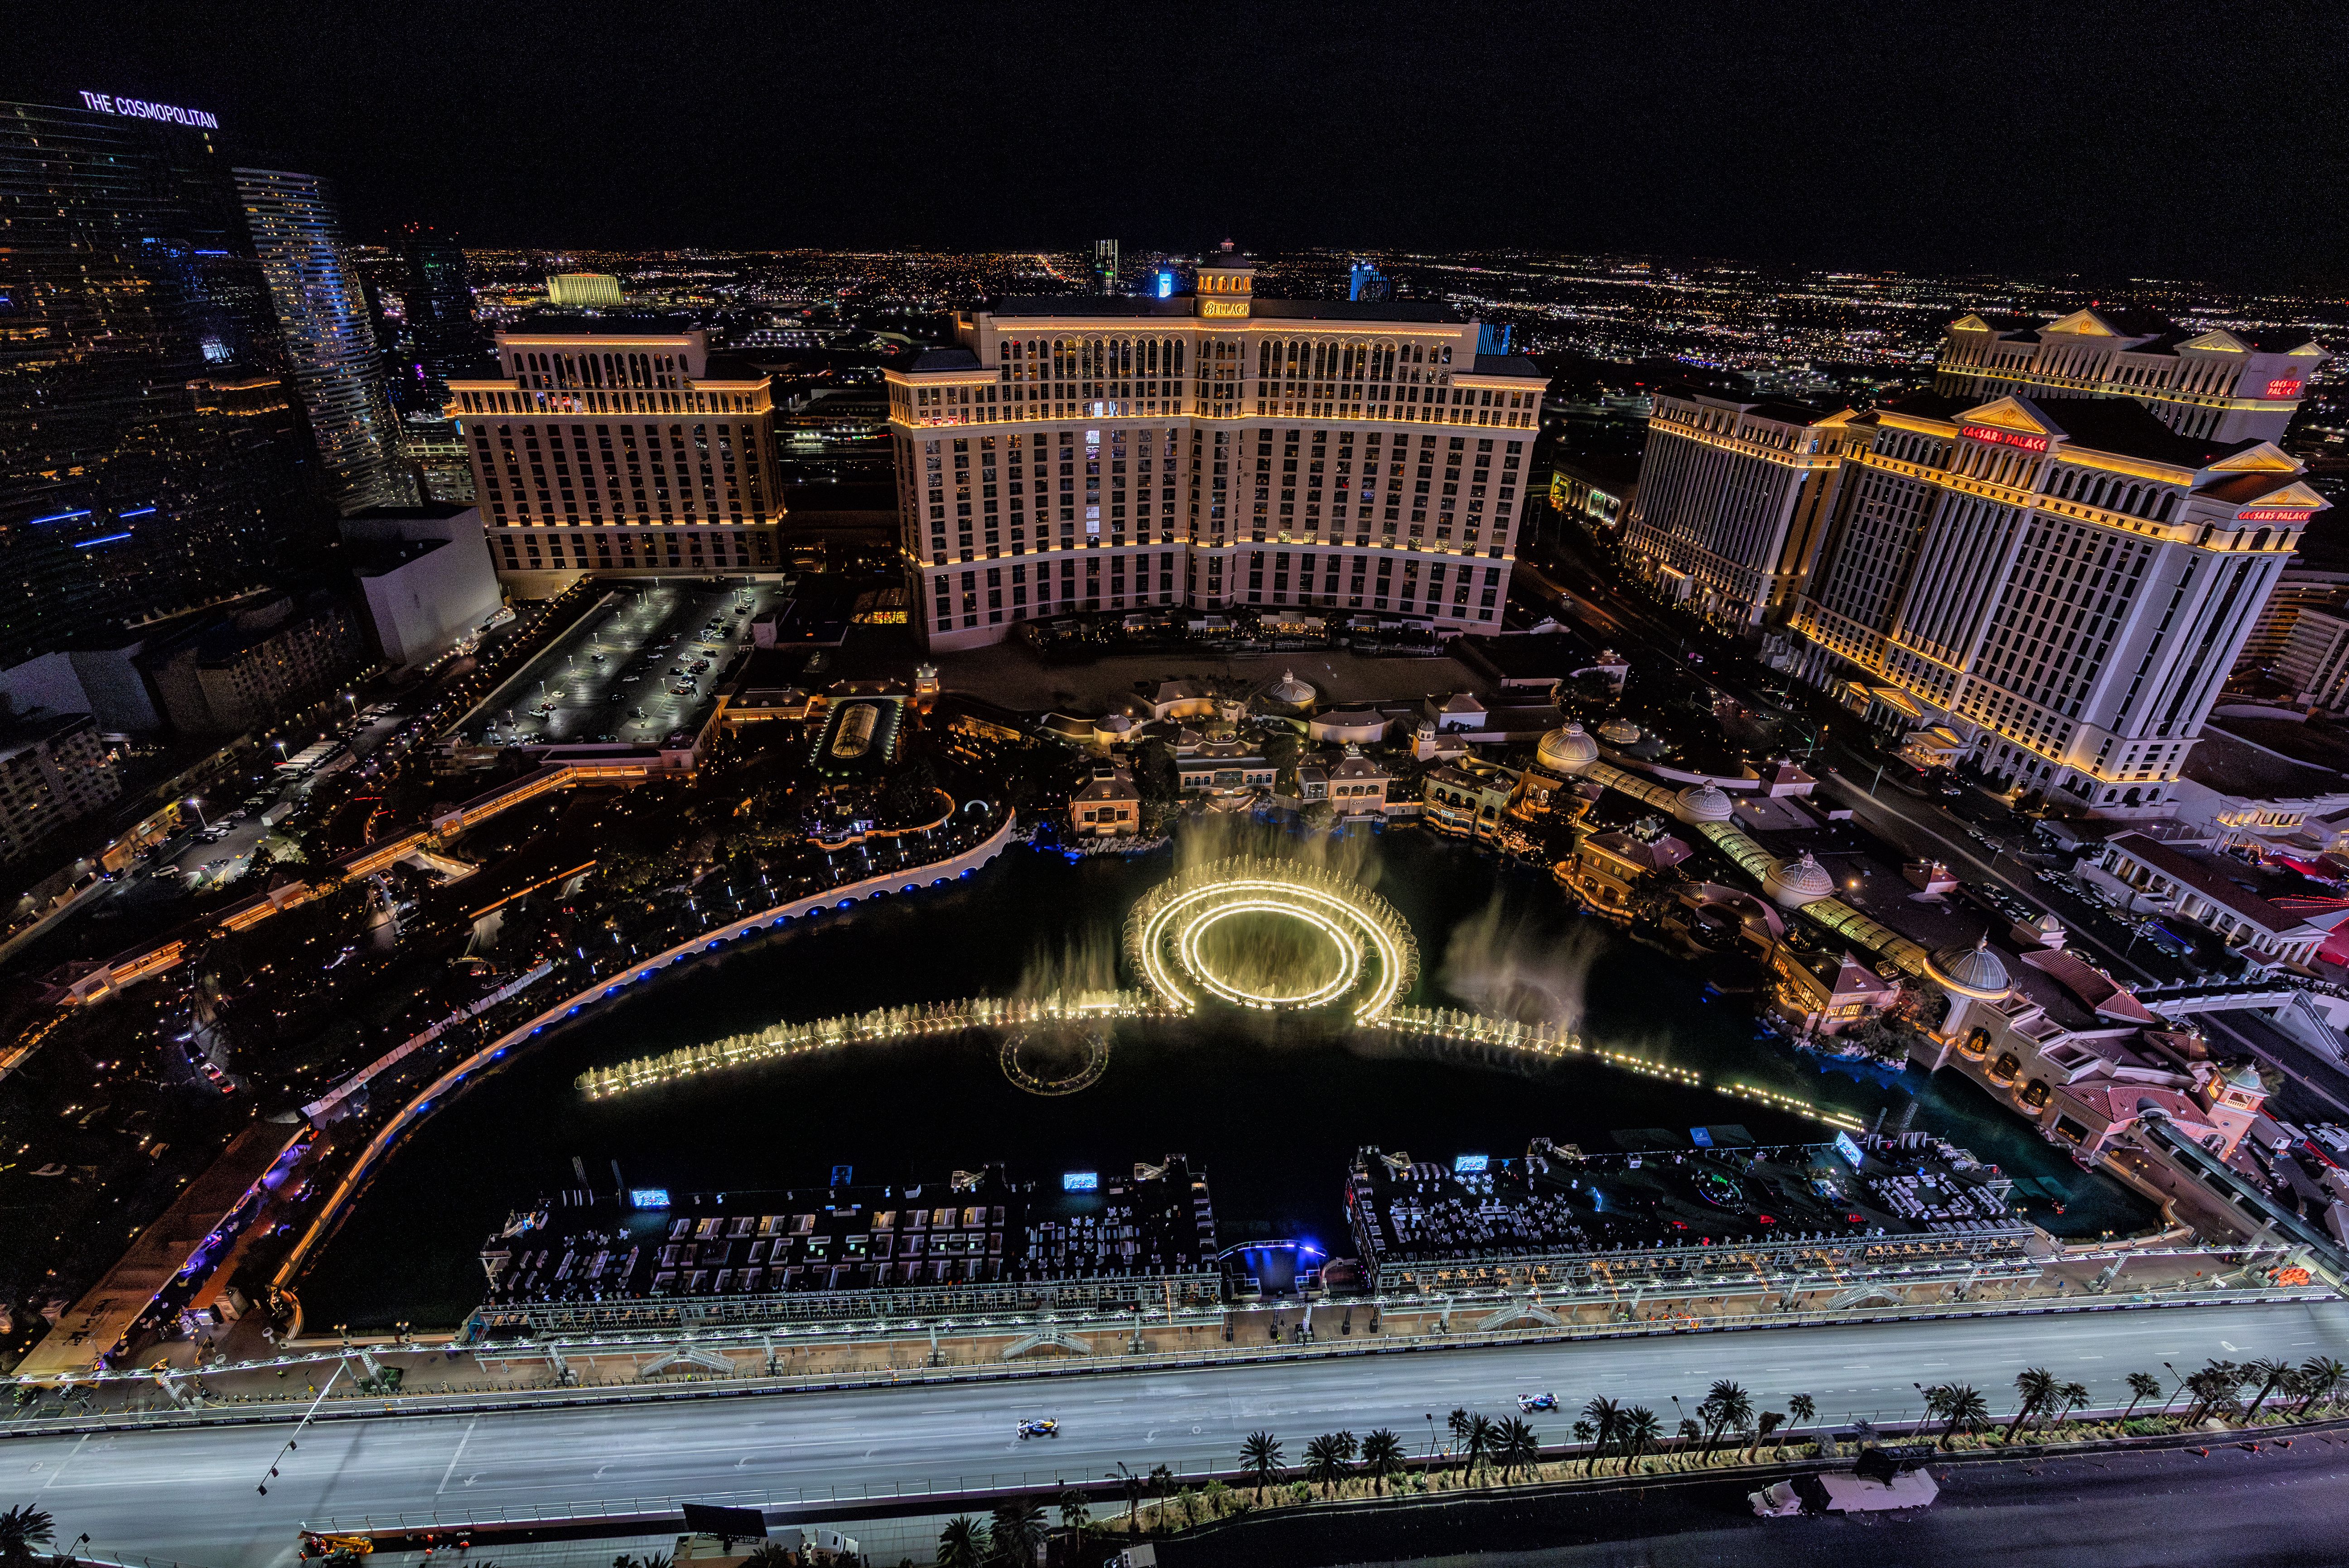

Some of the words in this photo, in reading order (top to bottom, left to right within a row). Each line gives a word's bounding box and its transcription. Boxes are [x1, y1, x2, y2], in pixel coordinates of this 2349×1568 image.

[80, 91, 114, 112] THE
[116, 97, 217, 129] COSMOPOLITAN
[1963, 426, 2002, 442] CAESARS
[2005, 434, 2046, 451] PALACE
[2238, 511, 2275, 520] CAESARS
[2276, 511, 2310, 520] PALACE
[1606, 852, 1618, 860] LOUIS
[1619, 858, 1636, 868] VUITTON
